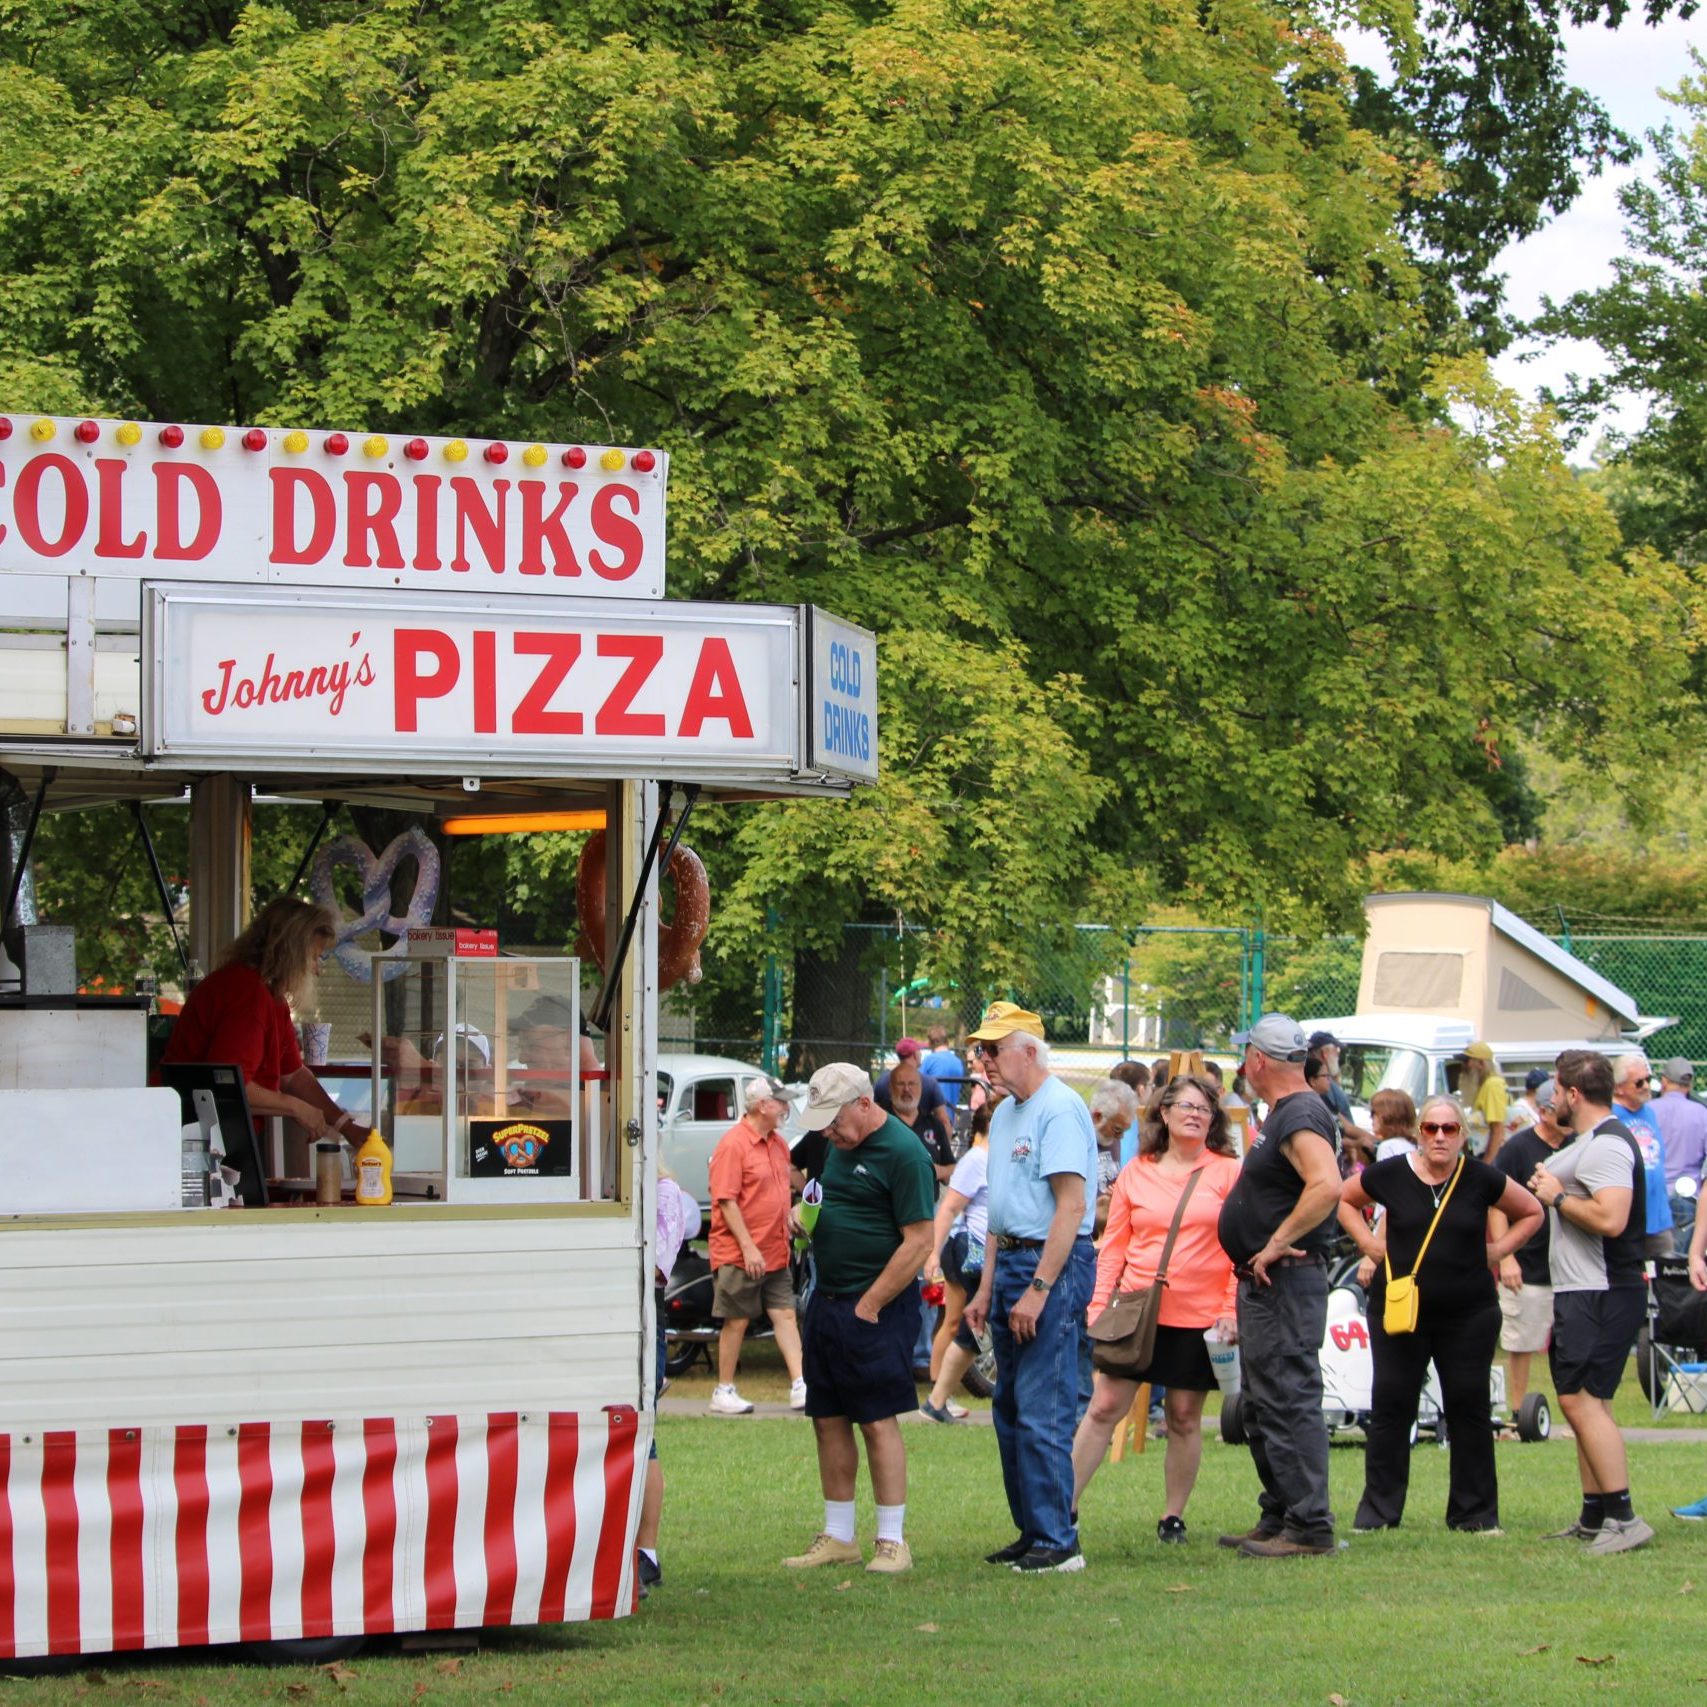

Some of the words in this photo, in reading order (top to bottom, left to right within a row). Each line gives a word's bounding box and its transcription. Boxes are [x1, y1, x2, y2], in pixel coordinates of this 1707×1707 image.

[0, 452, 223, 560] OLD
[268, 467, 645, 581] DRINKS
[201, 631, 376, 715] Johnny's
[394, 628, 754, 738] PIZZA
[830, 641, 861, 698] COLD
[824, 701, 869, 761] DRINKS
[1329, 1320, 1368, 1351] 64
